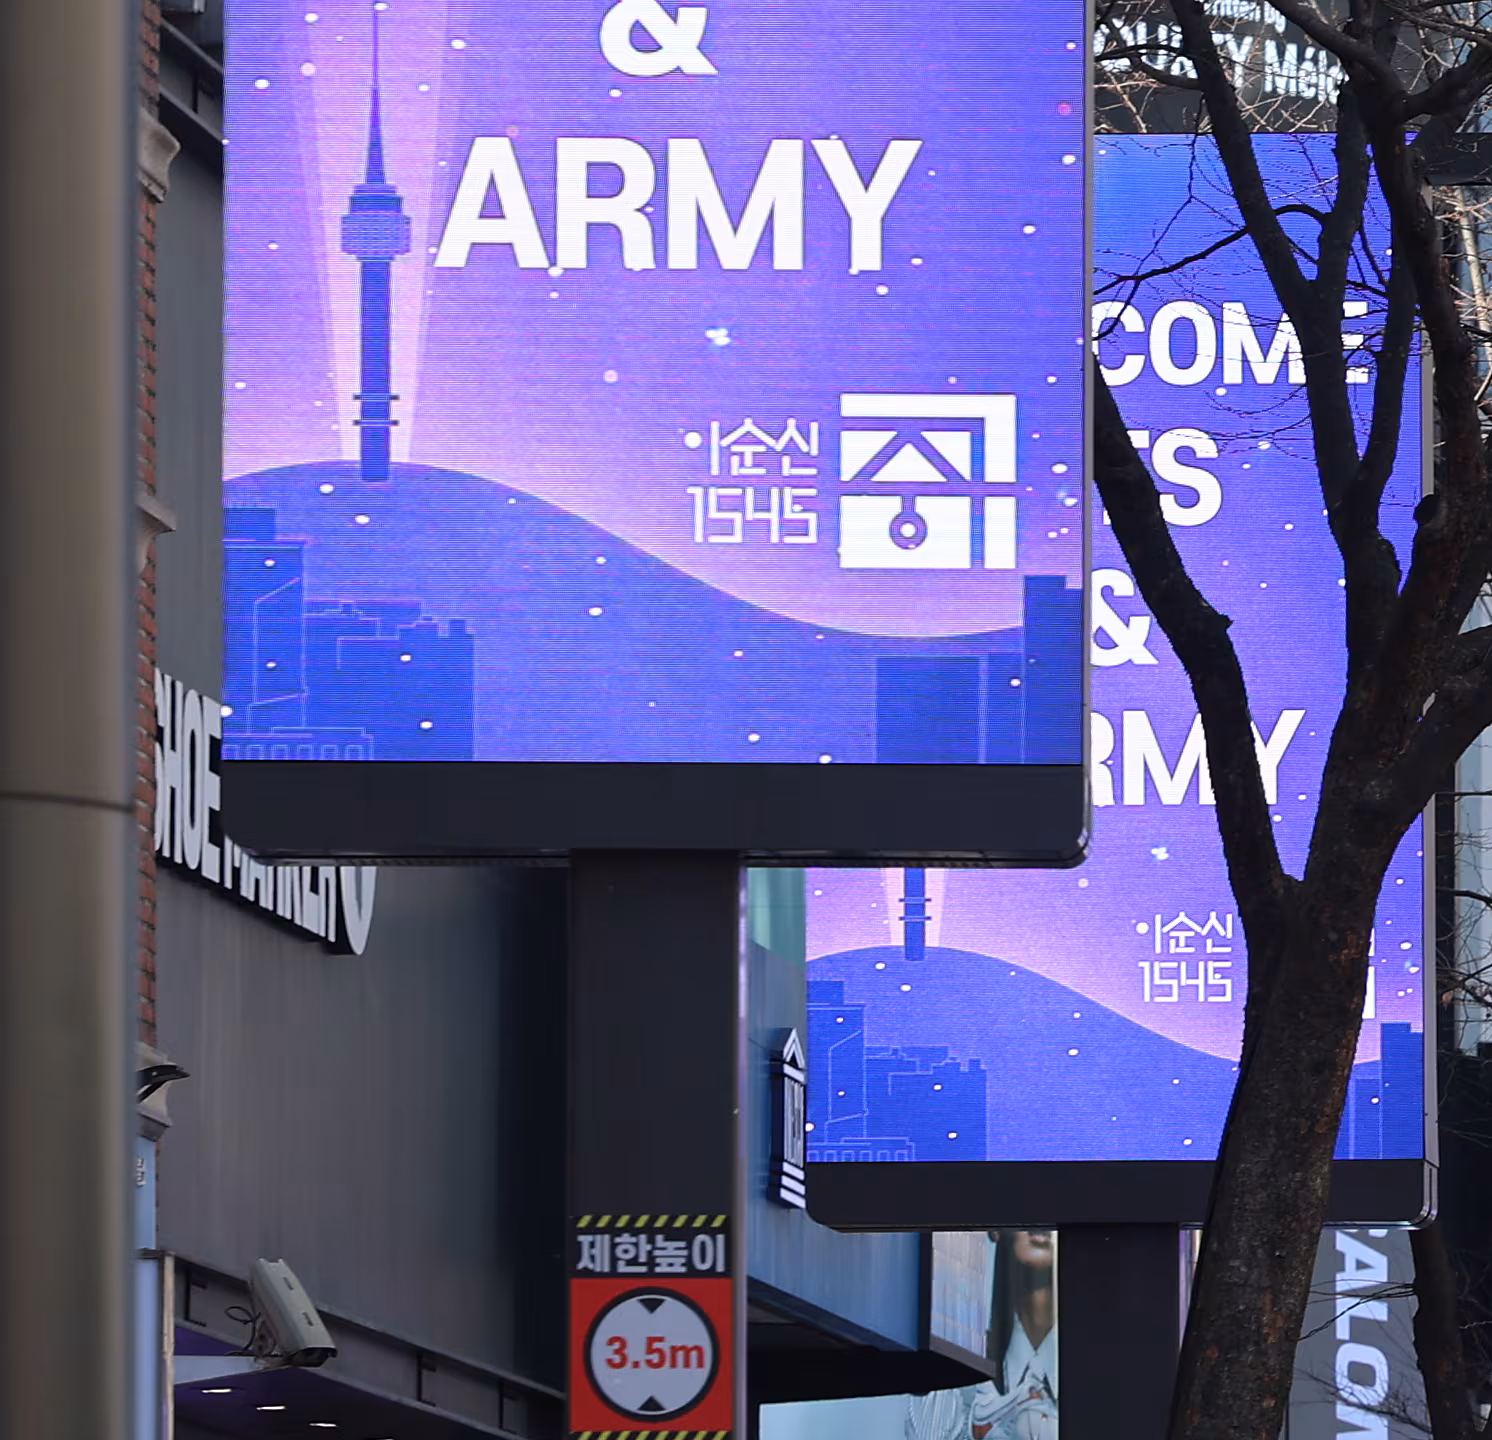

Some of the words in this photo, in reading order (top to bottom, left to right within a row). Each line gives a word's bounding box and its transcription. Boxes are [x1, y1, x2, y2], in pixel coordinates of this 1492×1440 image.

[600, 0, 718, 76] &
[434, 136, 923, 271] ARMY
[1091, 300, 1369, 386] COME
[684, 417, 819, 477] 이순신
[686, 486, 818, 544] 1545
[1090, 568, 1159, 667] &
[1135, 911, 1233, 954] 이순신
[1138, 960, 1232, 1003] 1545
[576, 1233, 727, 1274] 제한높이
[605, 1336, 706, 1370] 3.5m
